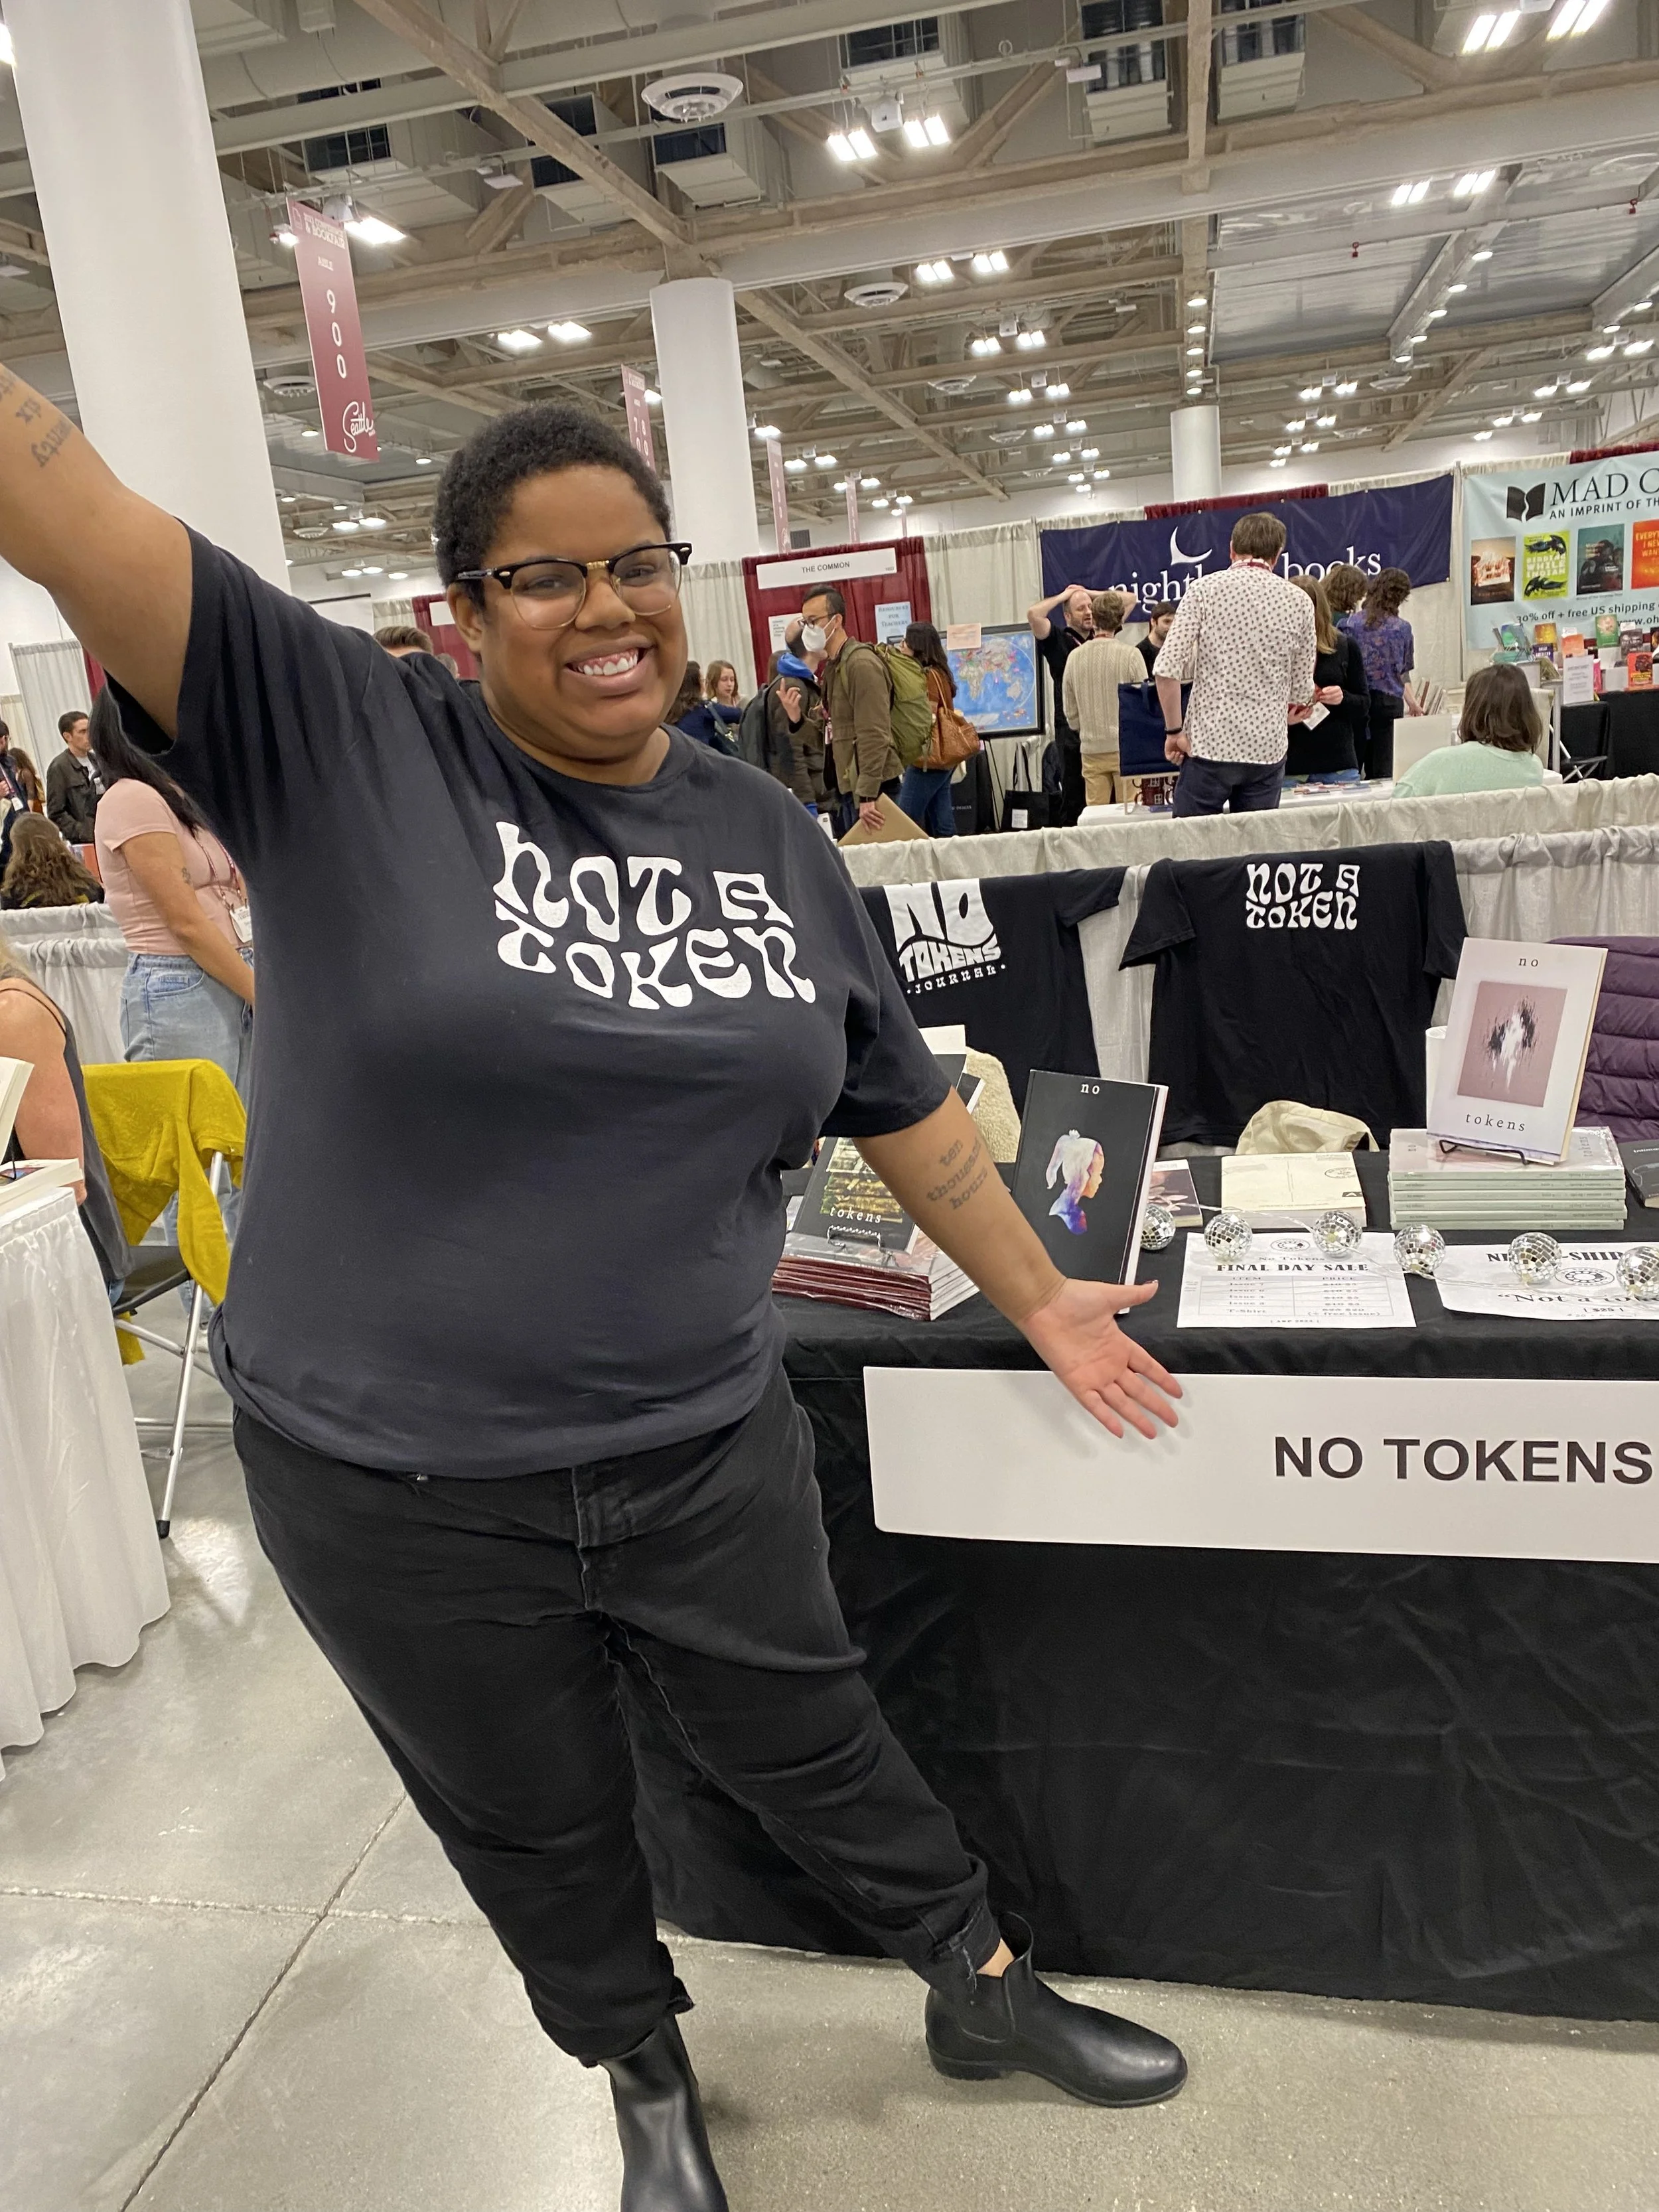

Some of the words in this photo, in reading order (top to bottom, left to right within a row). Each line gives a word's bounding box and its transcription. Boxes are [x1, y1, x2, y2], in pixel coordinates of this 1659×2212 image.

[326, 289, 347, 379] 900
[342, 401, 374, 453] Seattle
[1550, 473, 1629, 506] MAD
[1550, 508, 1565, 520] AN
[1571, 501, 1622, 517] IMPRINT
[1626, 499, 1642, 510] OF
[801, 564, 816, 573] THE
[817, 561, 851, 571] COMMON
[1516, 613, 1539, 623] 30%
[1542, 610, 1554, 619] off
[1567, 608, 1588, 618] free
[1591, 605, 1605, 615] US
[1609, 601, 1655, 614] shipping
[883, 877, 994, 953] NO
[898, 932, 1001, 983] TOKENS
[1518, 957, 1539, 968] no
[1080, 1082, 1100, 1095] no
[1465, 1112, 1526, 1132] tokens
[830, 1206, 882, 1224] tokens
[1274, 1436, 1363, 1479] NO
[1382, 1438, 1653, 1485] TOKENS
